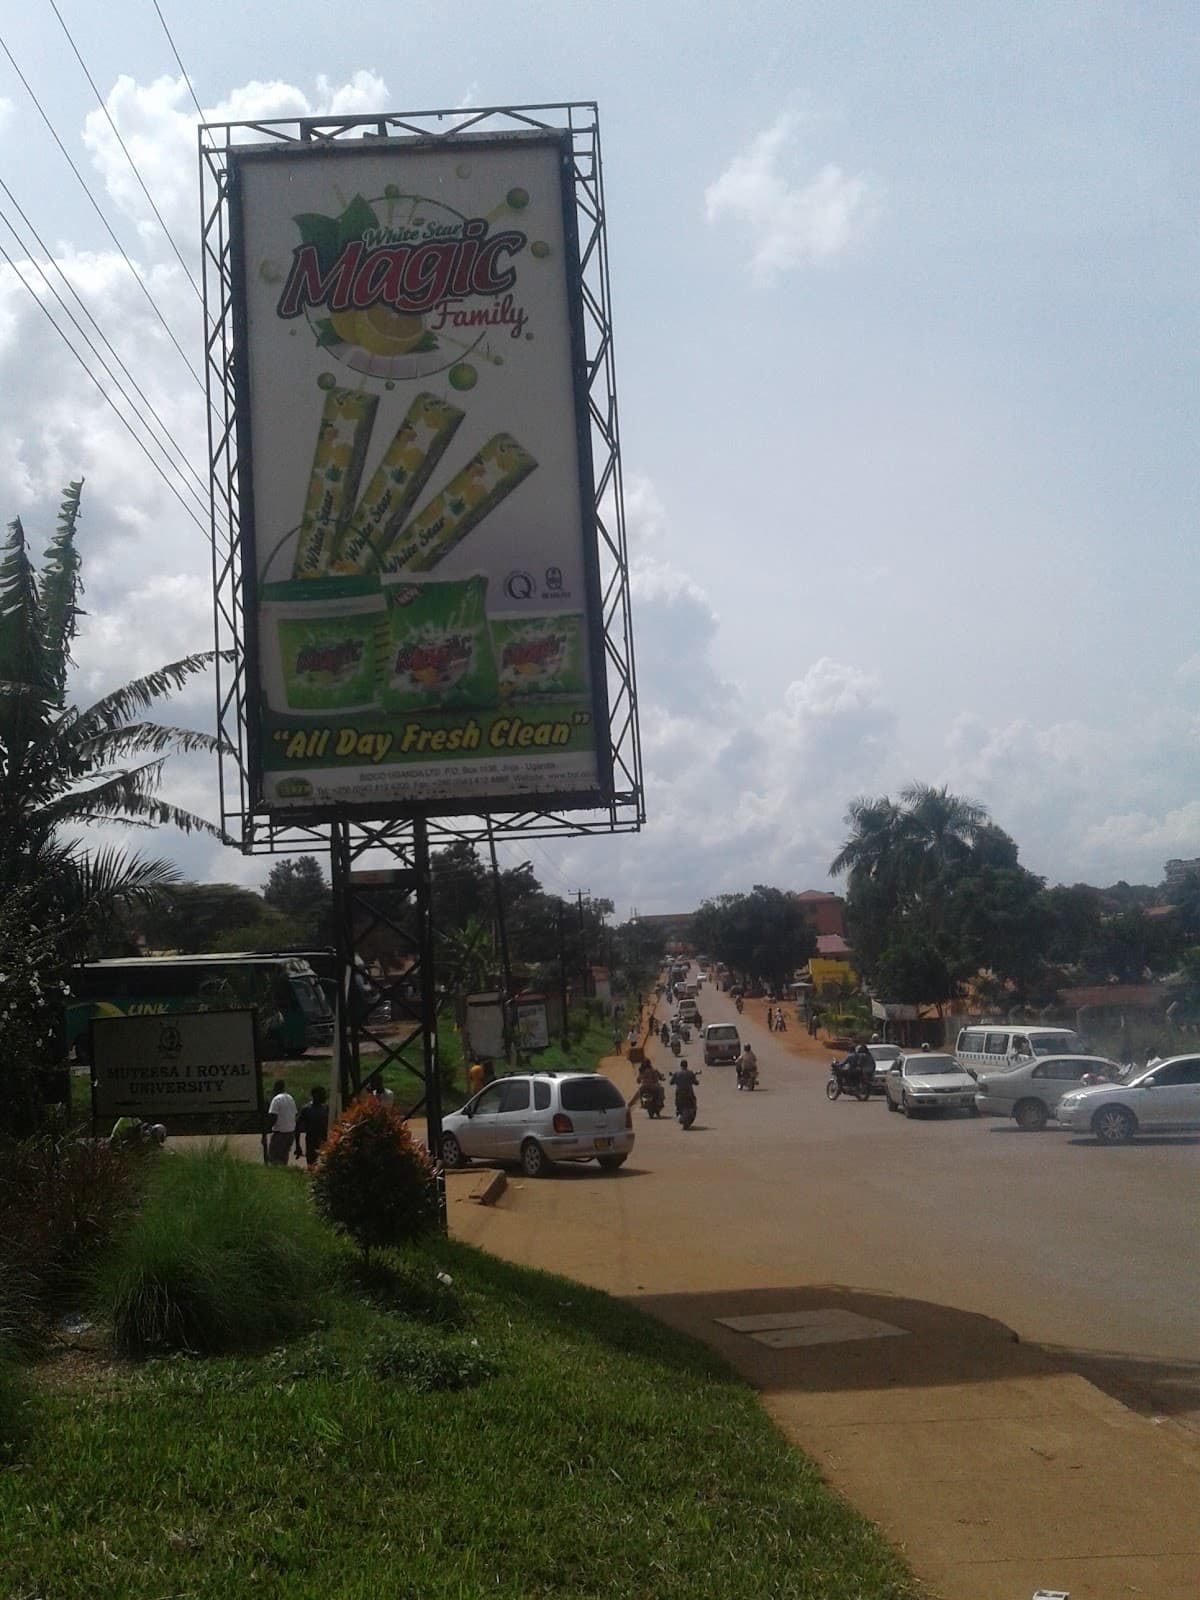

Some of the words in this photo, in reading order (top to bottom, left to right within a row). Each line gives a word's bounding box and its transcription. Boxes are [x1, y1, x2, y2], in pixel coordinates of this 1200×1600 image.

[363, 226, 419, 247] White
[422, 220, 462, 239] Star
[276, 217, 527, 319] Magic
[431, 294, 528, 338] Family
[335, 727, 392, 762] Day
[400, 719, 479, 753] Fresh
[129, 1080, 225, 1094] UNIVERSITY
[197, 1063, 250, 1077] ROYAL
